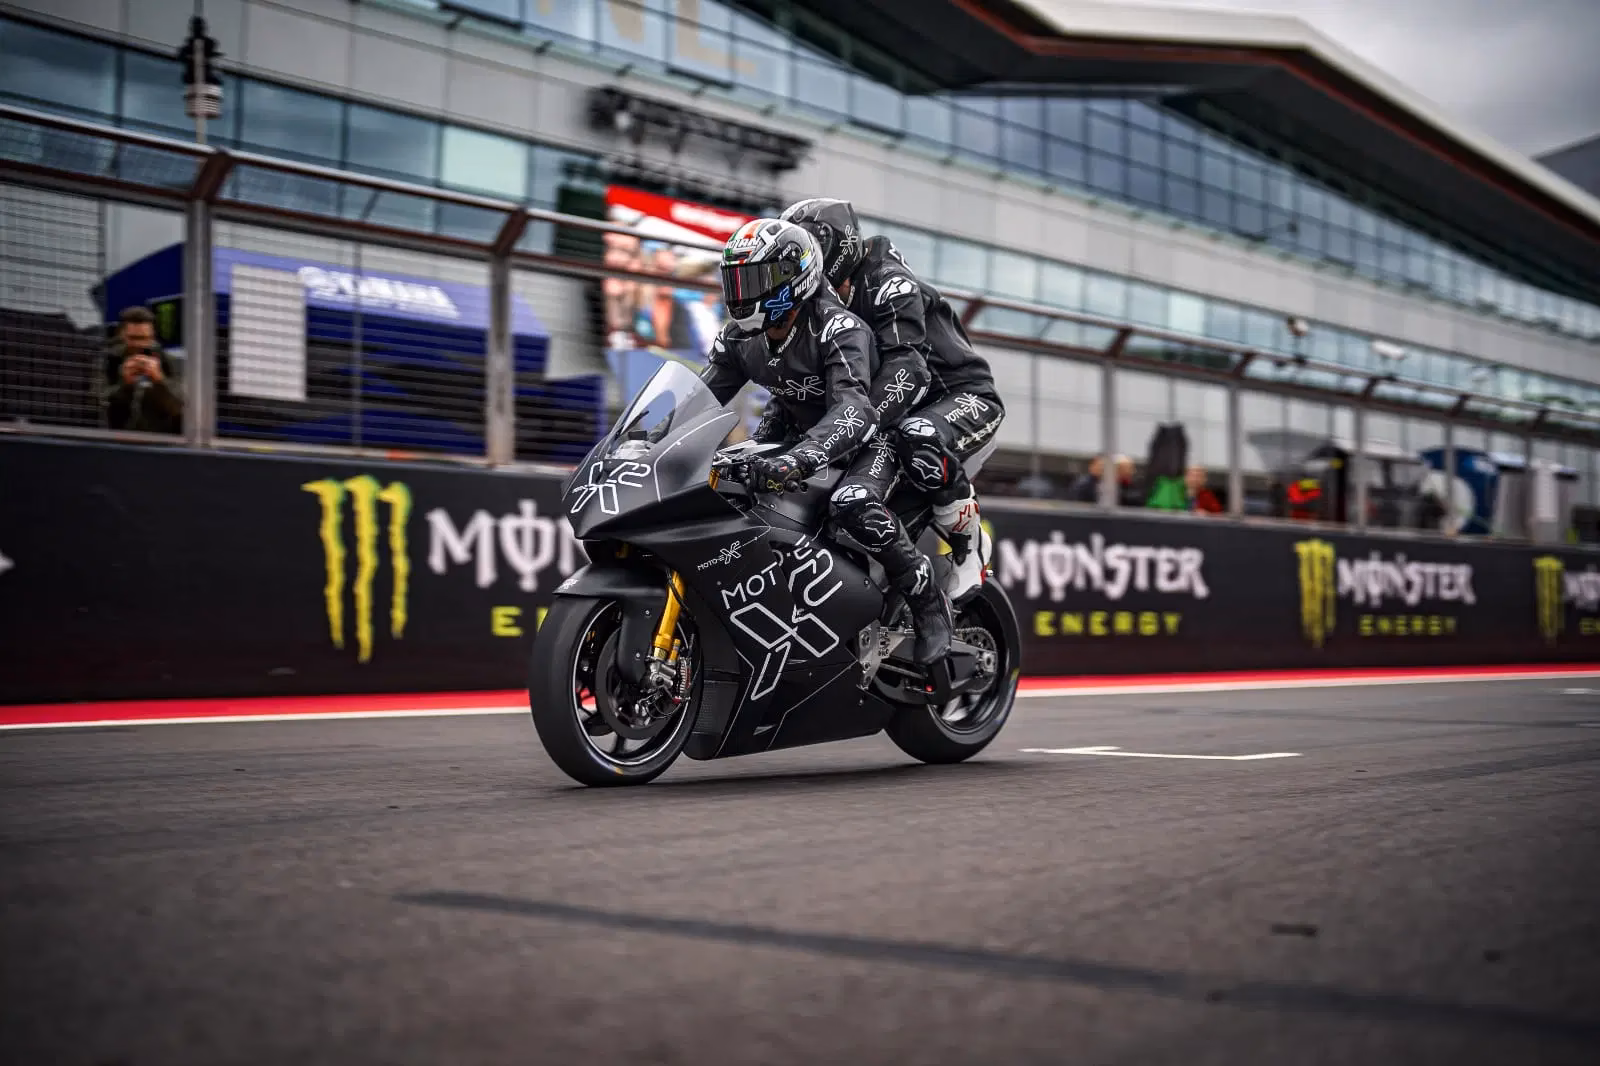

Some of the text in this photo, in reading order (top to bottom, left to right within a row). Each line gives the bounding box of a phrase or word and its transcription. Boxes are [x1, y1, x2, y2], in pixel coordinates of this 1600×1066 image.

[998, 530, 1210, 603] MONSTER
[1337, 550, 1477, 608] MONSTER
[1034, 610, 1182, 637] ENERGY
